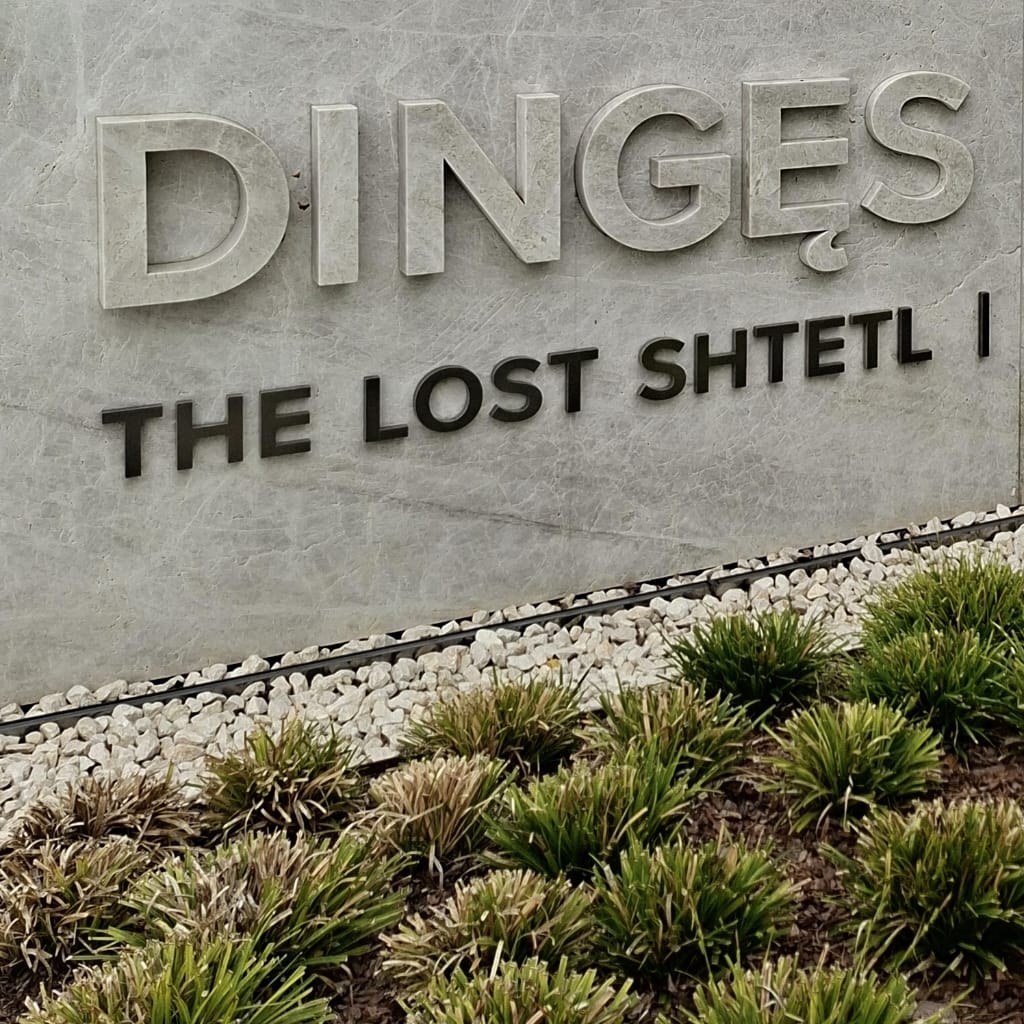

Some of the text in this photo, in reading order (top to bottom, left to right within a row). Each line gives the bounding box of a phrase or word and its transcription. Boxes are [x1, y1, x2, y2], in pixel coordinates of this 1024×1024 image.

[95, 70, 975, 310] DINGĘS
[101, 385, 312, 478] THE
[363, 346, 599, 443] LOST
[637, 306, 933, 402] SHTETL
